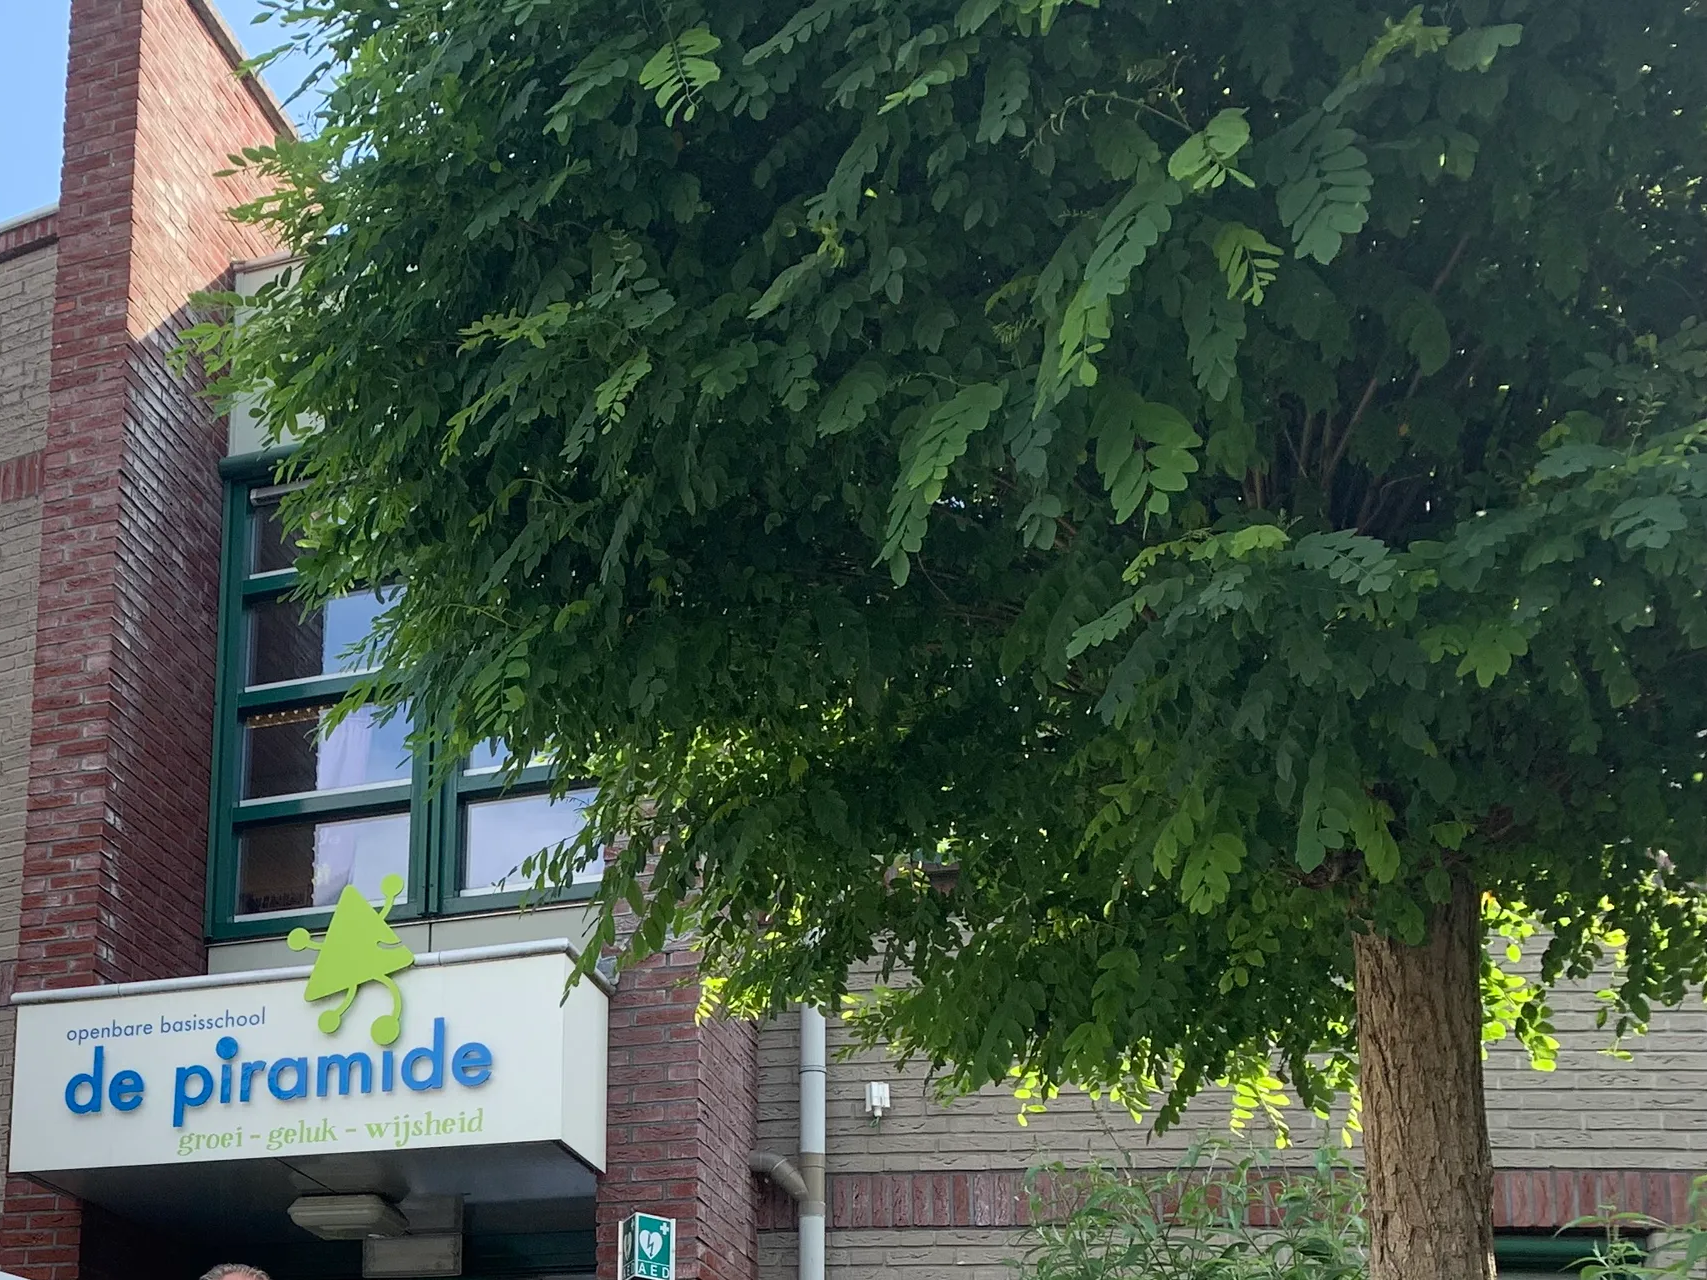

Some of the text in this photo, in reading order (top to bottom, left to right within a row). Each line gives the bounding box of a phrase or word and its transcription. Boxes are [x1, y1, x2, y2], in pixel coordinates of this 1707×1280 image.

[66, 1006, 266, 1045] openbare basisschool
[65, 1016, 493, 1128] de piramide
[177, 1125, 243, 1156] groei
[265, 1118, 338, 1151] geluk
[365, 1108, 484, 1148] wijsheid
[638, 1262, 671, 1279] AED
